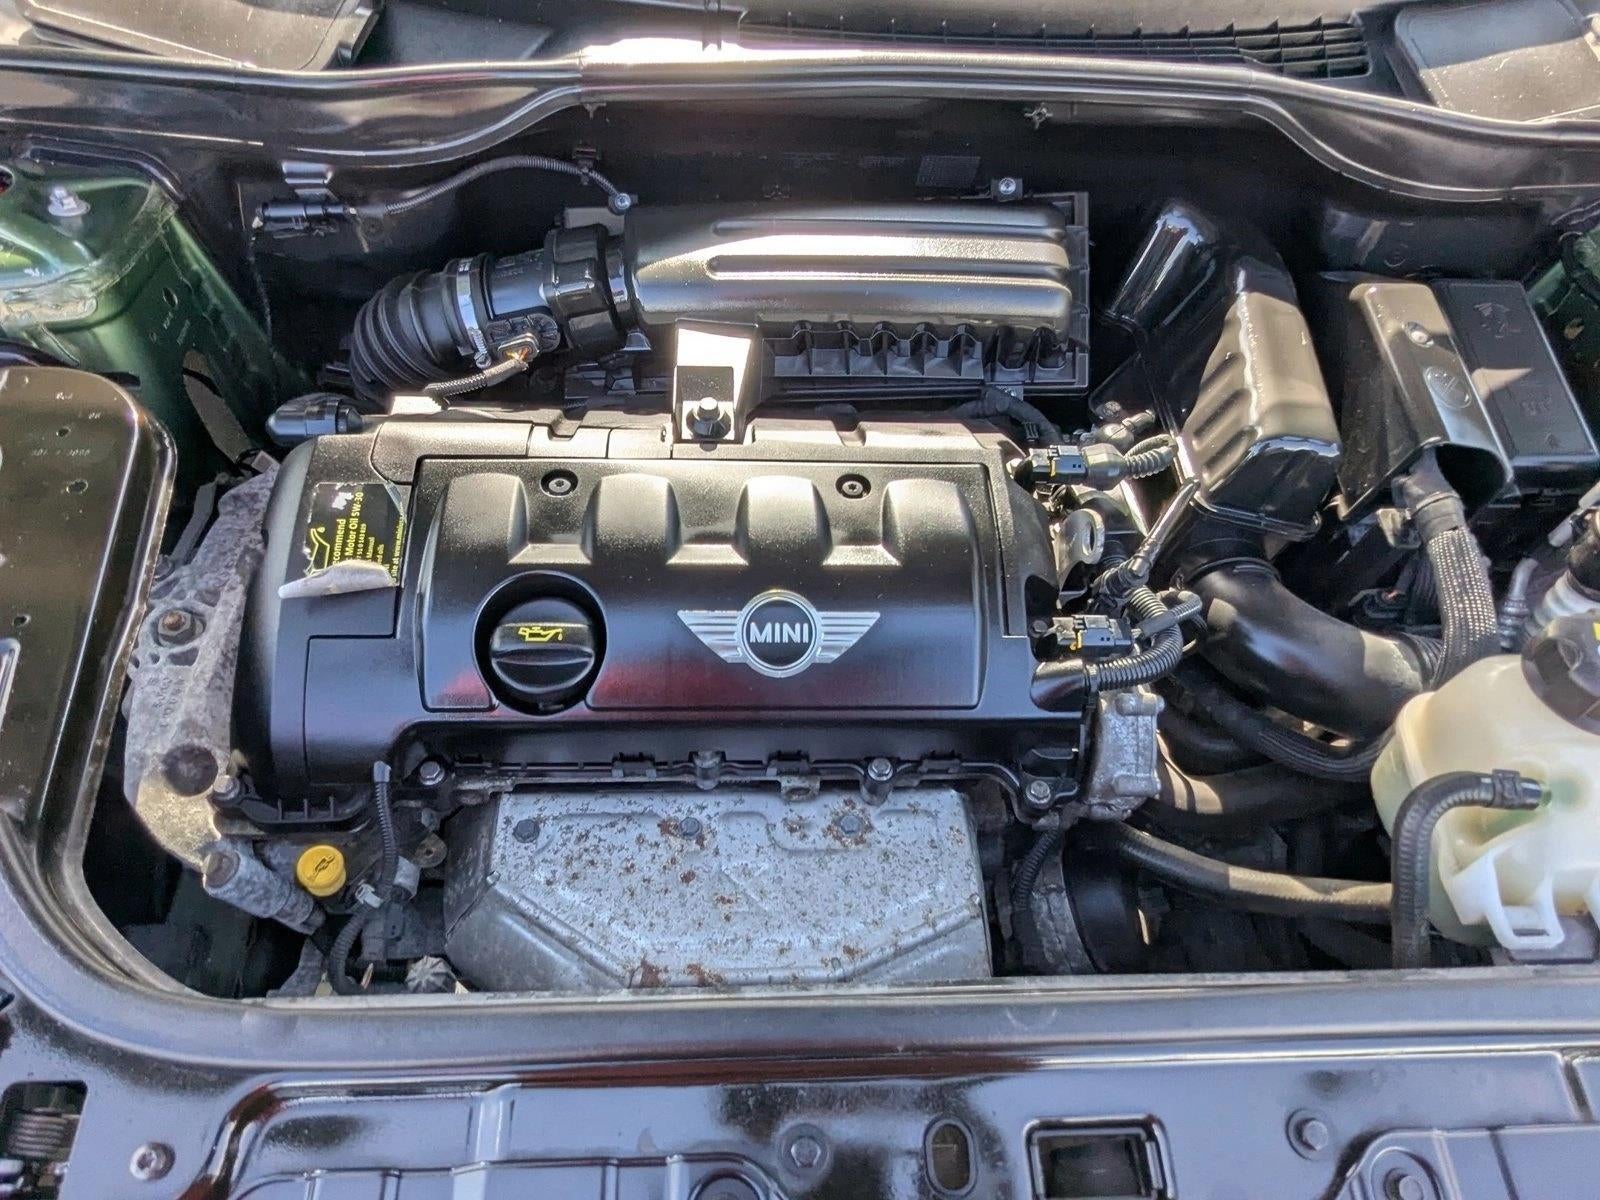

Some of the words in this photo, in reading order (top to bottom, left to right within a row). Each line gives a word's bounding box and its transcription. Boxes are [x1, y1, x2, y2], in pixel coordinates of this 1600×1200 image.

[351, 491, 364, 517] 5W-30
[349, 517, 359, 530] Oil
[333, 518, 346, 566] ecommend
[345, 530, 357, 556] Motor
[366, 536, 375, 559] Manual
[377, 543, 385, 554] oils
[391, 565, 399, 577] site
[392, 557, 400, 565] at
[749, 621, 809, 643] MINI
